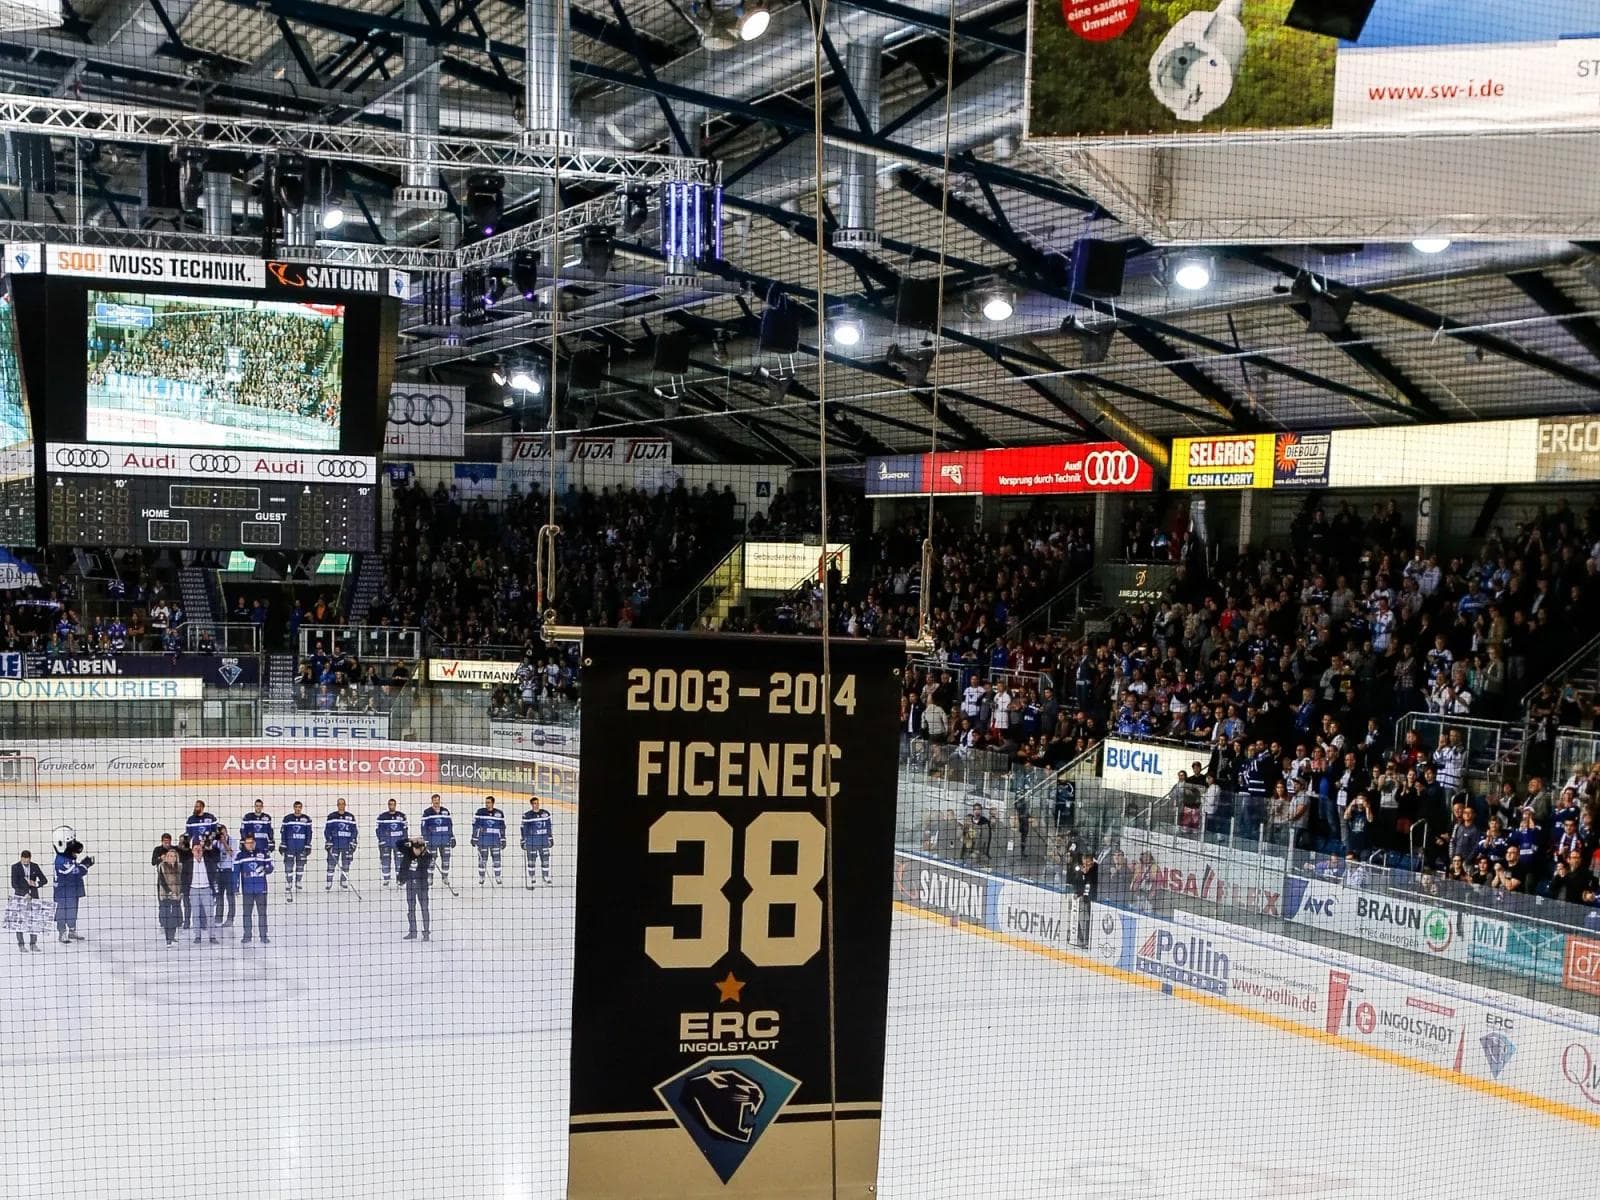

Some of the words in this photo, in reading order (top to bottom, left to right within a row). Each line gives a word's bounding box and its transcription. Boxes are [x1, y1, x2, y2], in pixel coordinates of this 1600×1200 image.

[1081, 9, 1128, 32] Umwelt!
[1368, 79, 1505, 102] www.sw-i.de
[109, 253, 163, 277] MUSS
[169, 257, 252, 283] TECHNIK.
[306, 265, 380, 292] SATURN
[1539, 421, 1600, 453] ERGO
[569, 438, 616, 463] TUJA
[625, 438, 670, 464] TUJA
[1188, 438, 1256, 467] SELGROS
[1286, 445, 1320, 458] DIEBOLD
[123, 452, 176, 470] Audi
[254, 458, 305, 475] Audi
[1064, 460, 1082, 471] Audi
[998, 475, 1033, 487] Vorsprung
[1034, 473, 1054, 484] durch
[1054, 472, 1082, 483] Technik
[141, 509, 170, 518] HOME
[255, 512, 288, 522] GUEST
[458, 669, 519, 682] WITTMANN
[0, 680, 178, 699] DONAUKURIER
[265, 726, 386, 739] STIEFEL
[37, 763, 95, 771] FUTURECOM
[107, 762, 165, 770] FUTURECOM
[222, 754, 276, 771] Audi
[284, 757, 372, 774] quattro
[637, 740, 842, 797] FICENEC
[1106, 746, 1163, 775] BÜCHL
[644, 811, 827, 968] 38
[918, 869, 984, 920] SATURN
[1357, 896, 1421, 930] BRAUN
[1156, 929, 1229, 980] Pollin
[1231, 977, 1317, 1013] www.pollin.de
[679, 1010, 780, 1040] ERC
[1380, 1009, 1455, 1044] INGOLSTADT
[1486, 1013, 1515, 1029] ERC
[679, 1040, 780, 1053] INGOLSTADT
